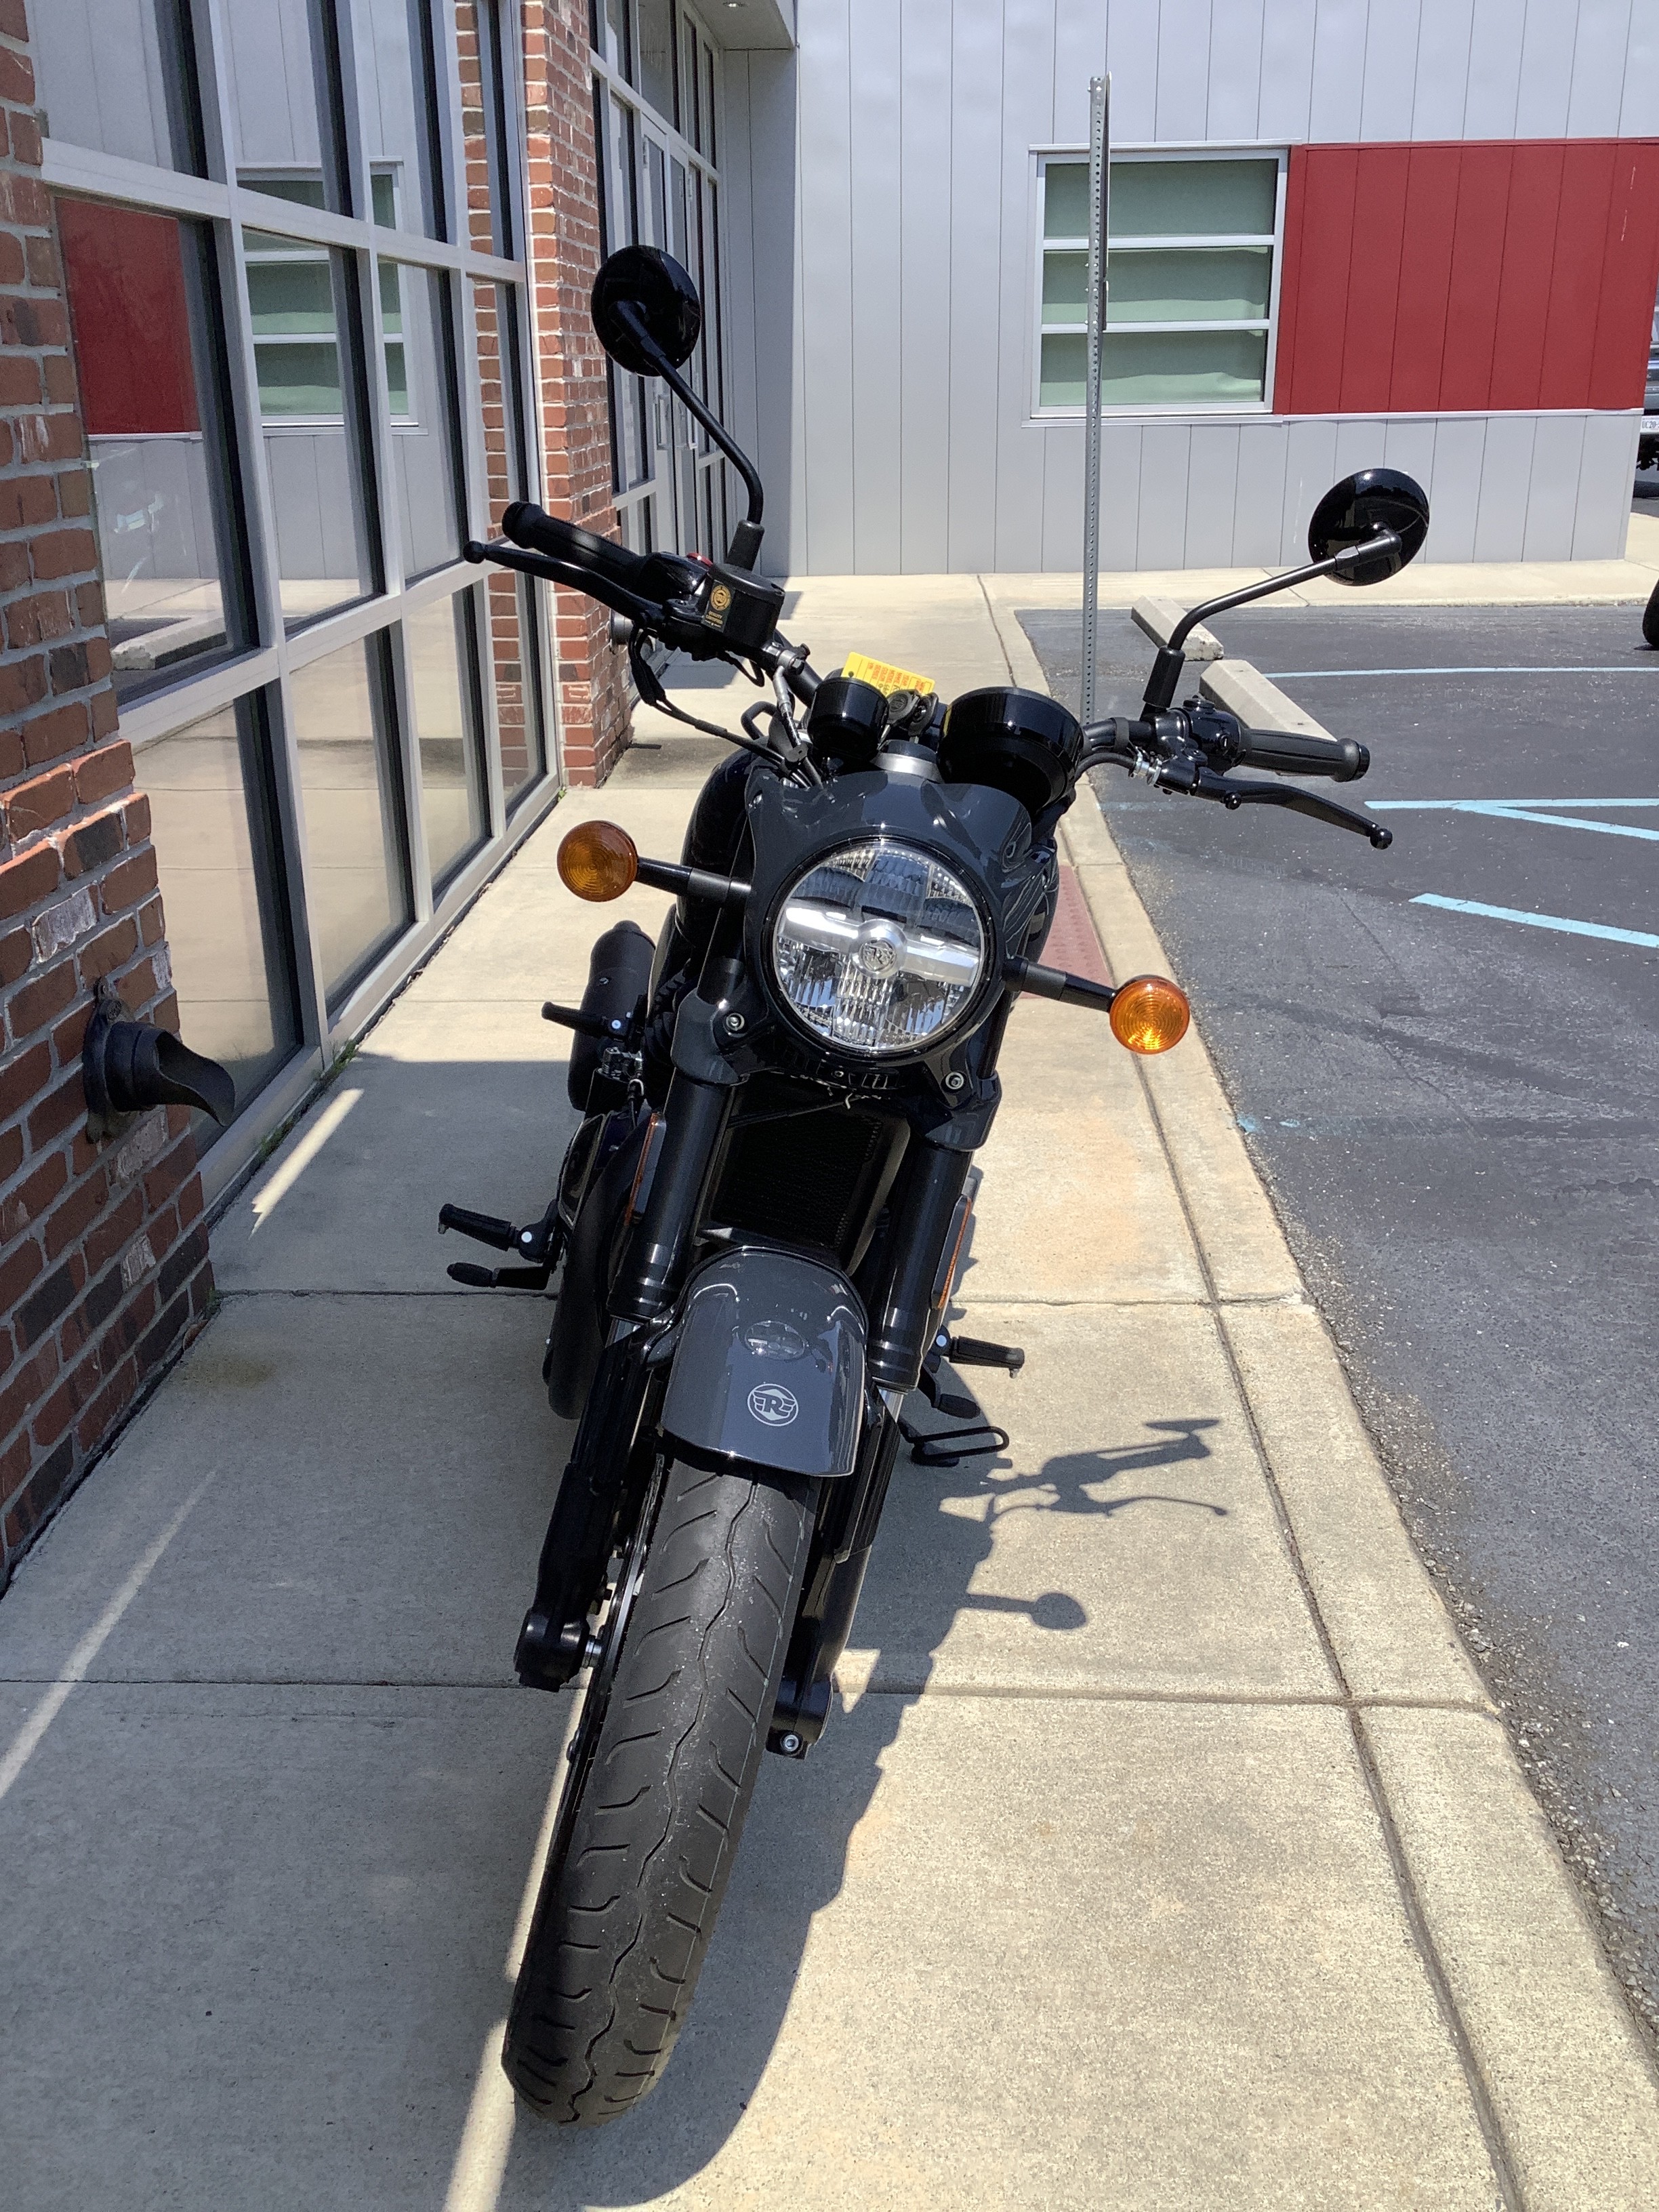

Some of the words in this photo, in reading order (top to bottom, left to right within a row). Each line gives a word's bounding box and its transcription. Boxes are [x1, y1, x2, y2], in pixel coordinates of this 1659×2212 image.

[878, 666, 888, 682] COLOR
[885, 668, 896, 683] MODEL
[893, 672, 903, 684] MAKE
